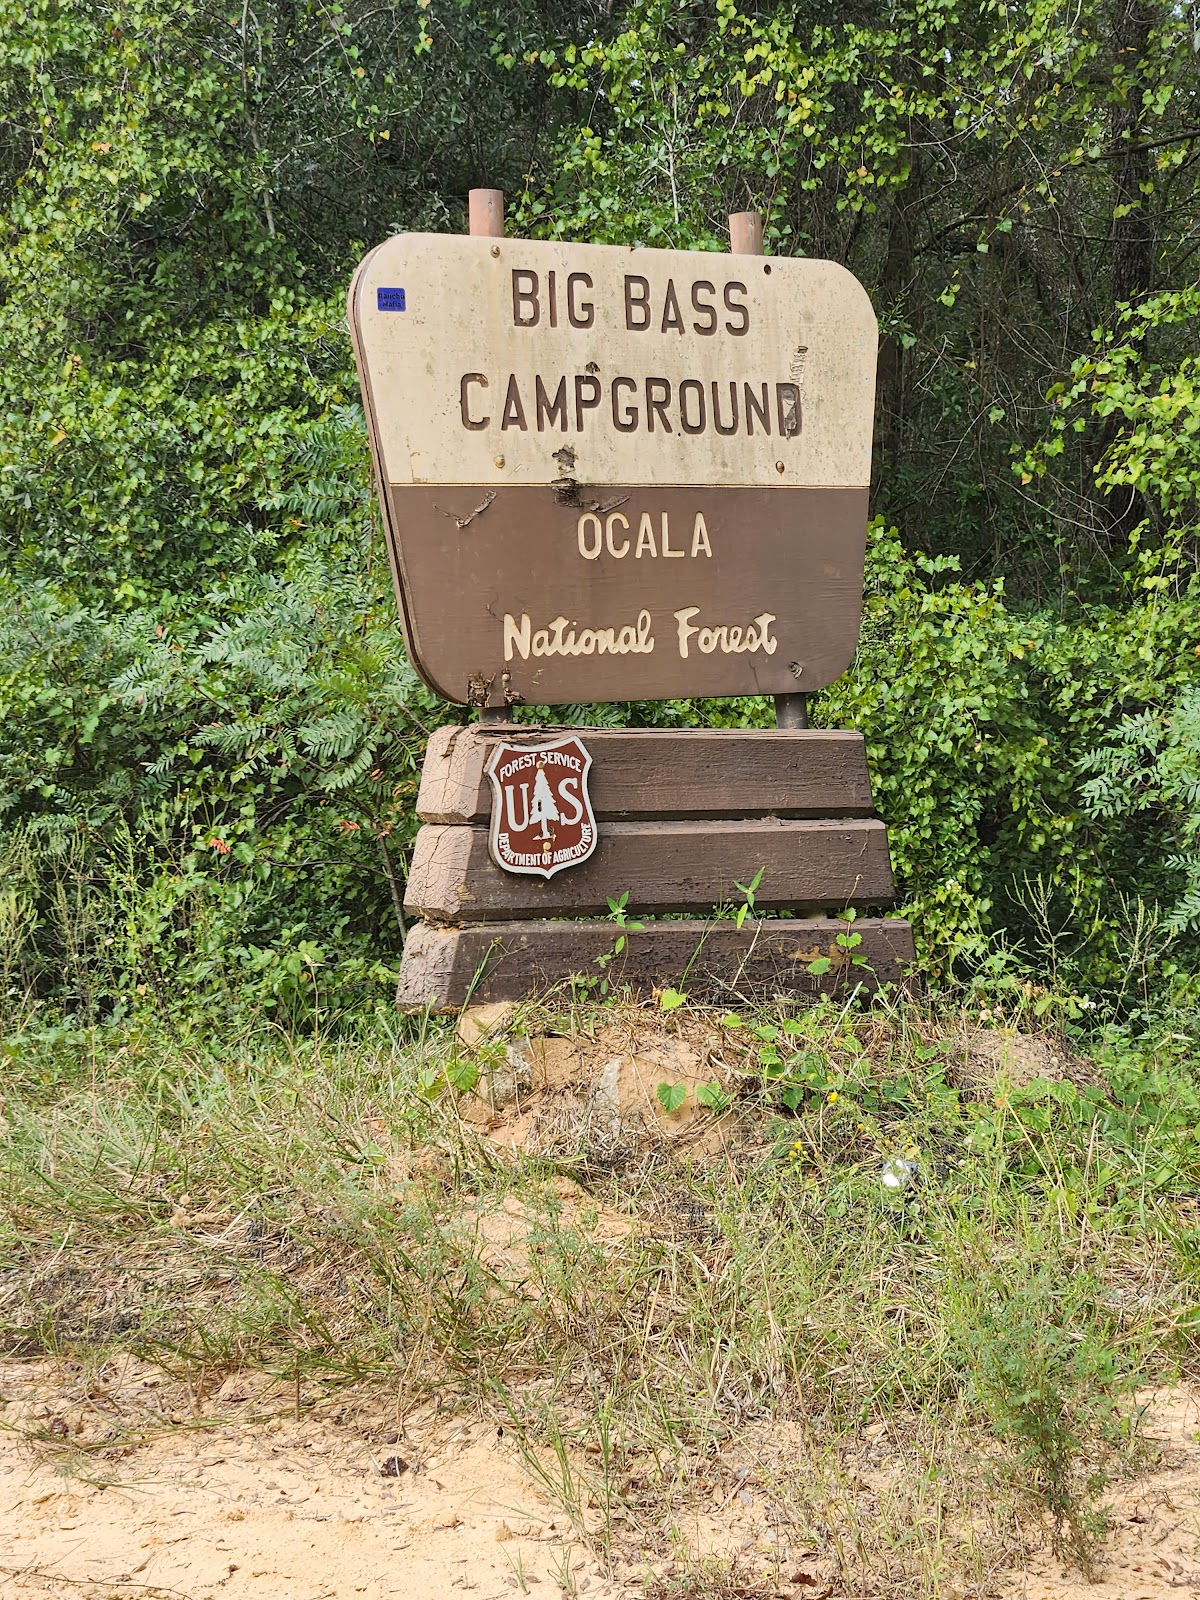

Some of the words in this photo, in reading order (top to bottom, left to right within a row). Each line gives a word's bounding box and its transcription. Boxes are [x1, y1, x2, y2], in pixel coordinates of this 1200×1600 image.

[512, 269, 595, 329] BIG
[624, 274, 750, 337] BASS
[459, 372, 803, 438] CAMPGROUND
[577, 510, 712, 560] OCALA
[503, 609, 655, 662] National
[674, 606, 777, 659] Forest
[500, 753, 537, 782] FOREST
[539, 752, 582, 772] SERVICE
[498, 832, 541, 866] DEPARTMENT
[542, 852, 553, 865] OF
[553, 822, 592, 863] AGRICULTURE
